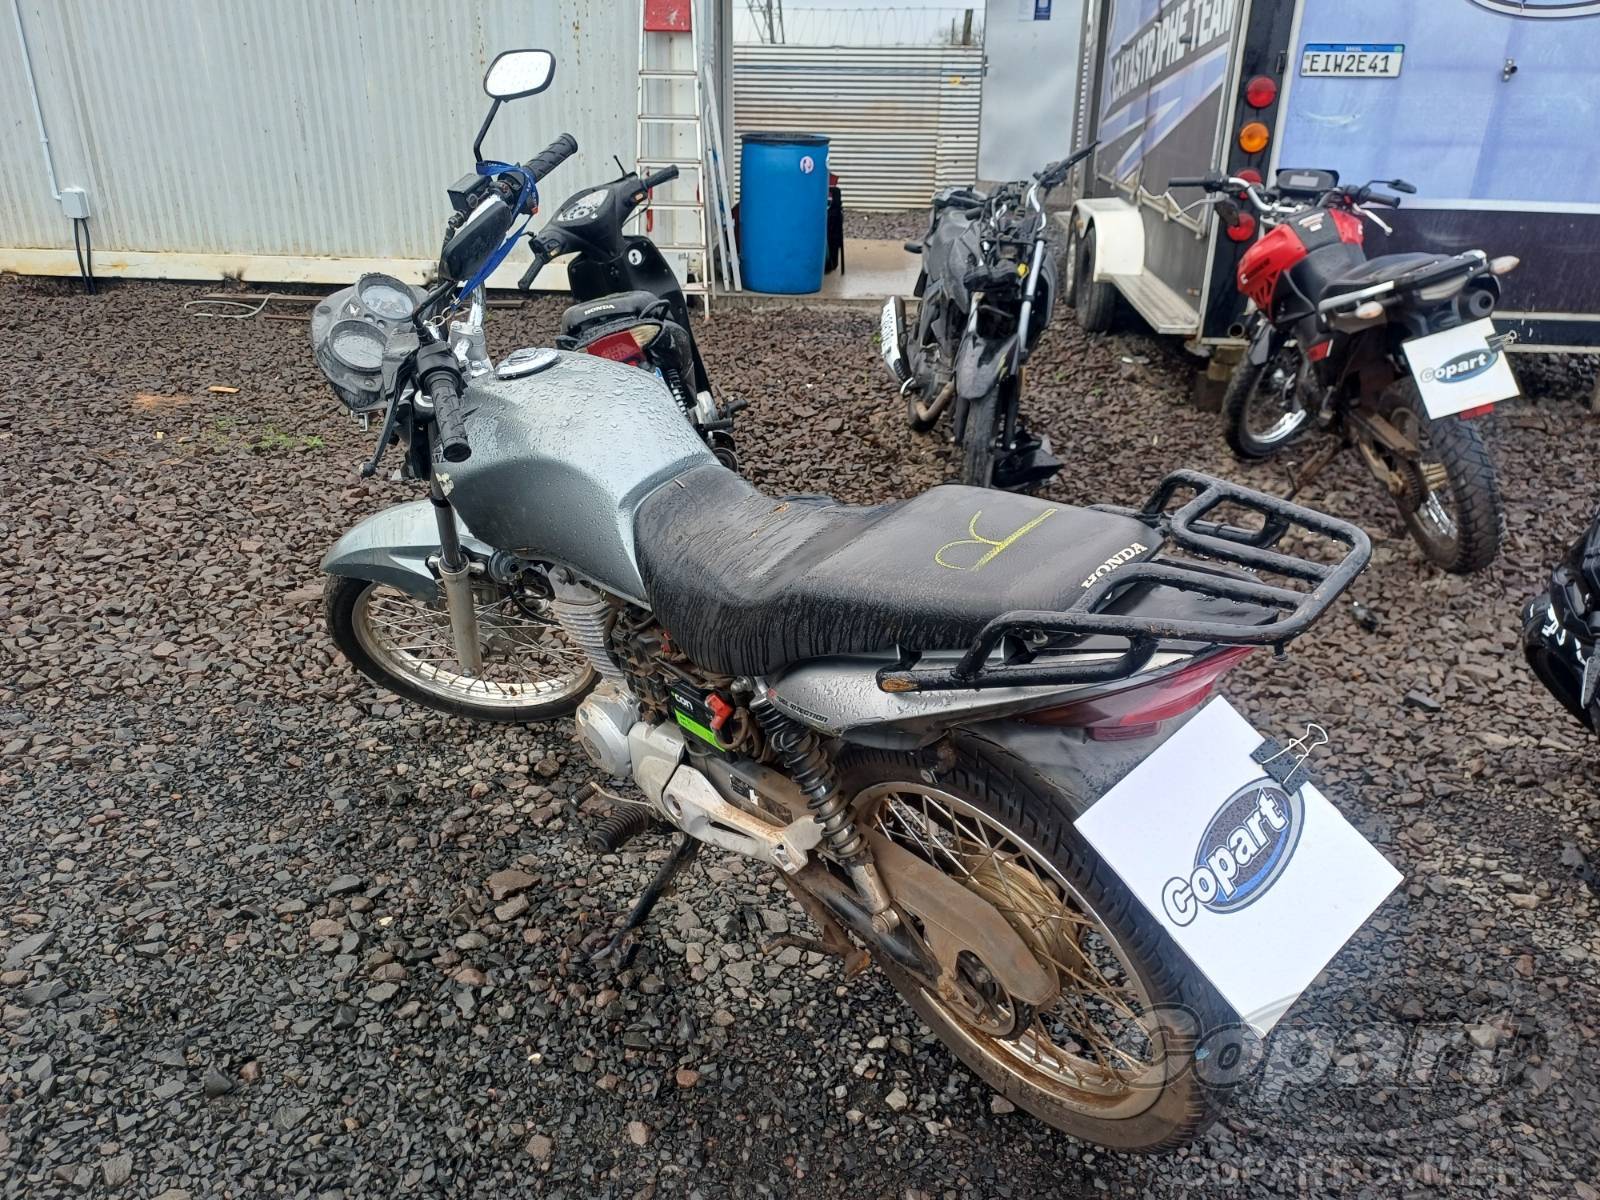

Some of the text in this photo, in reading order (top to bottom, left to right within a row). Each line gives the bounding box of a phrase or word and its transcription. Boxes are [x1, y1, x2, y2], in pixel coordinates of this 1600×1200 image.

[1111, 0, 1192, 101] CATASTROPHE
[1309, 54, 1390, 73] EIW2E41
[583, 304, 616, 315] HONDA
[1420, 353, 1487, 383] Copart
[1161, 786, 1289, 928] Copart
